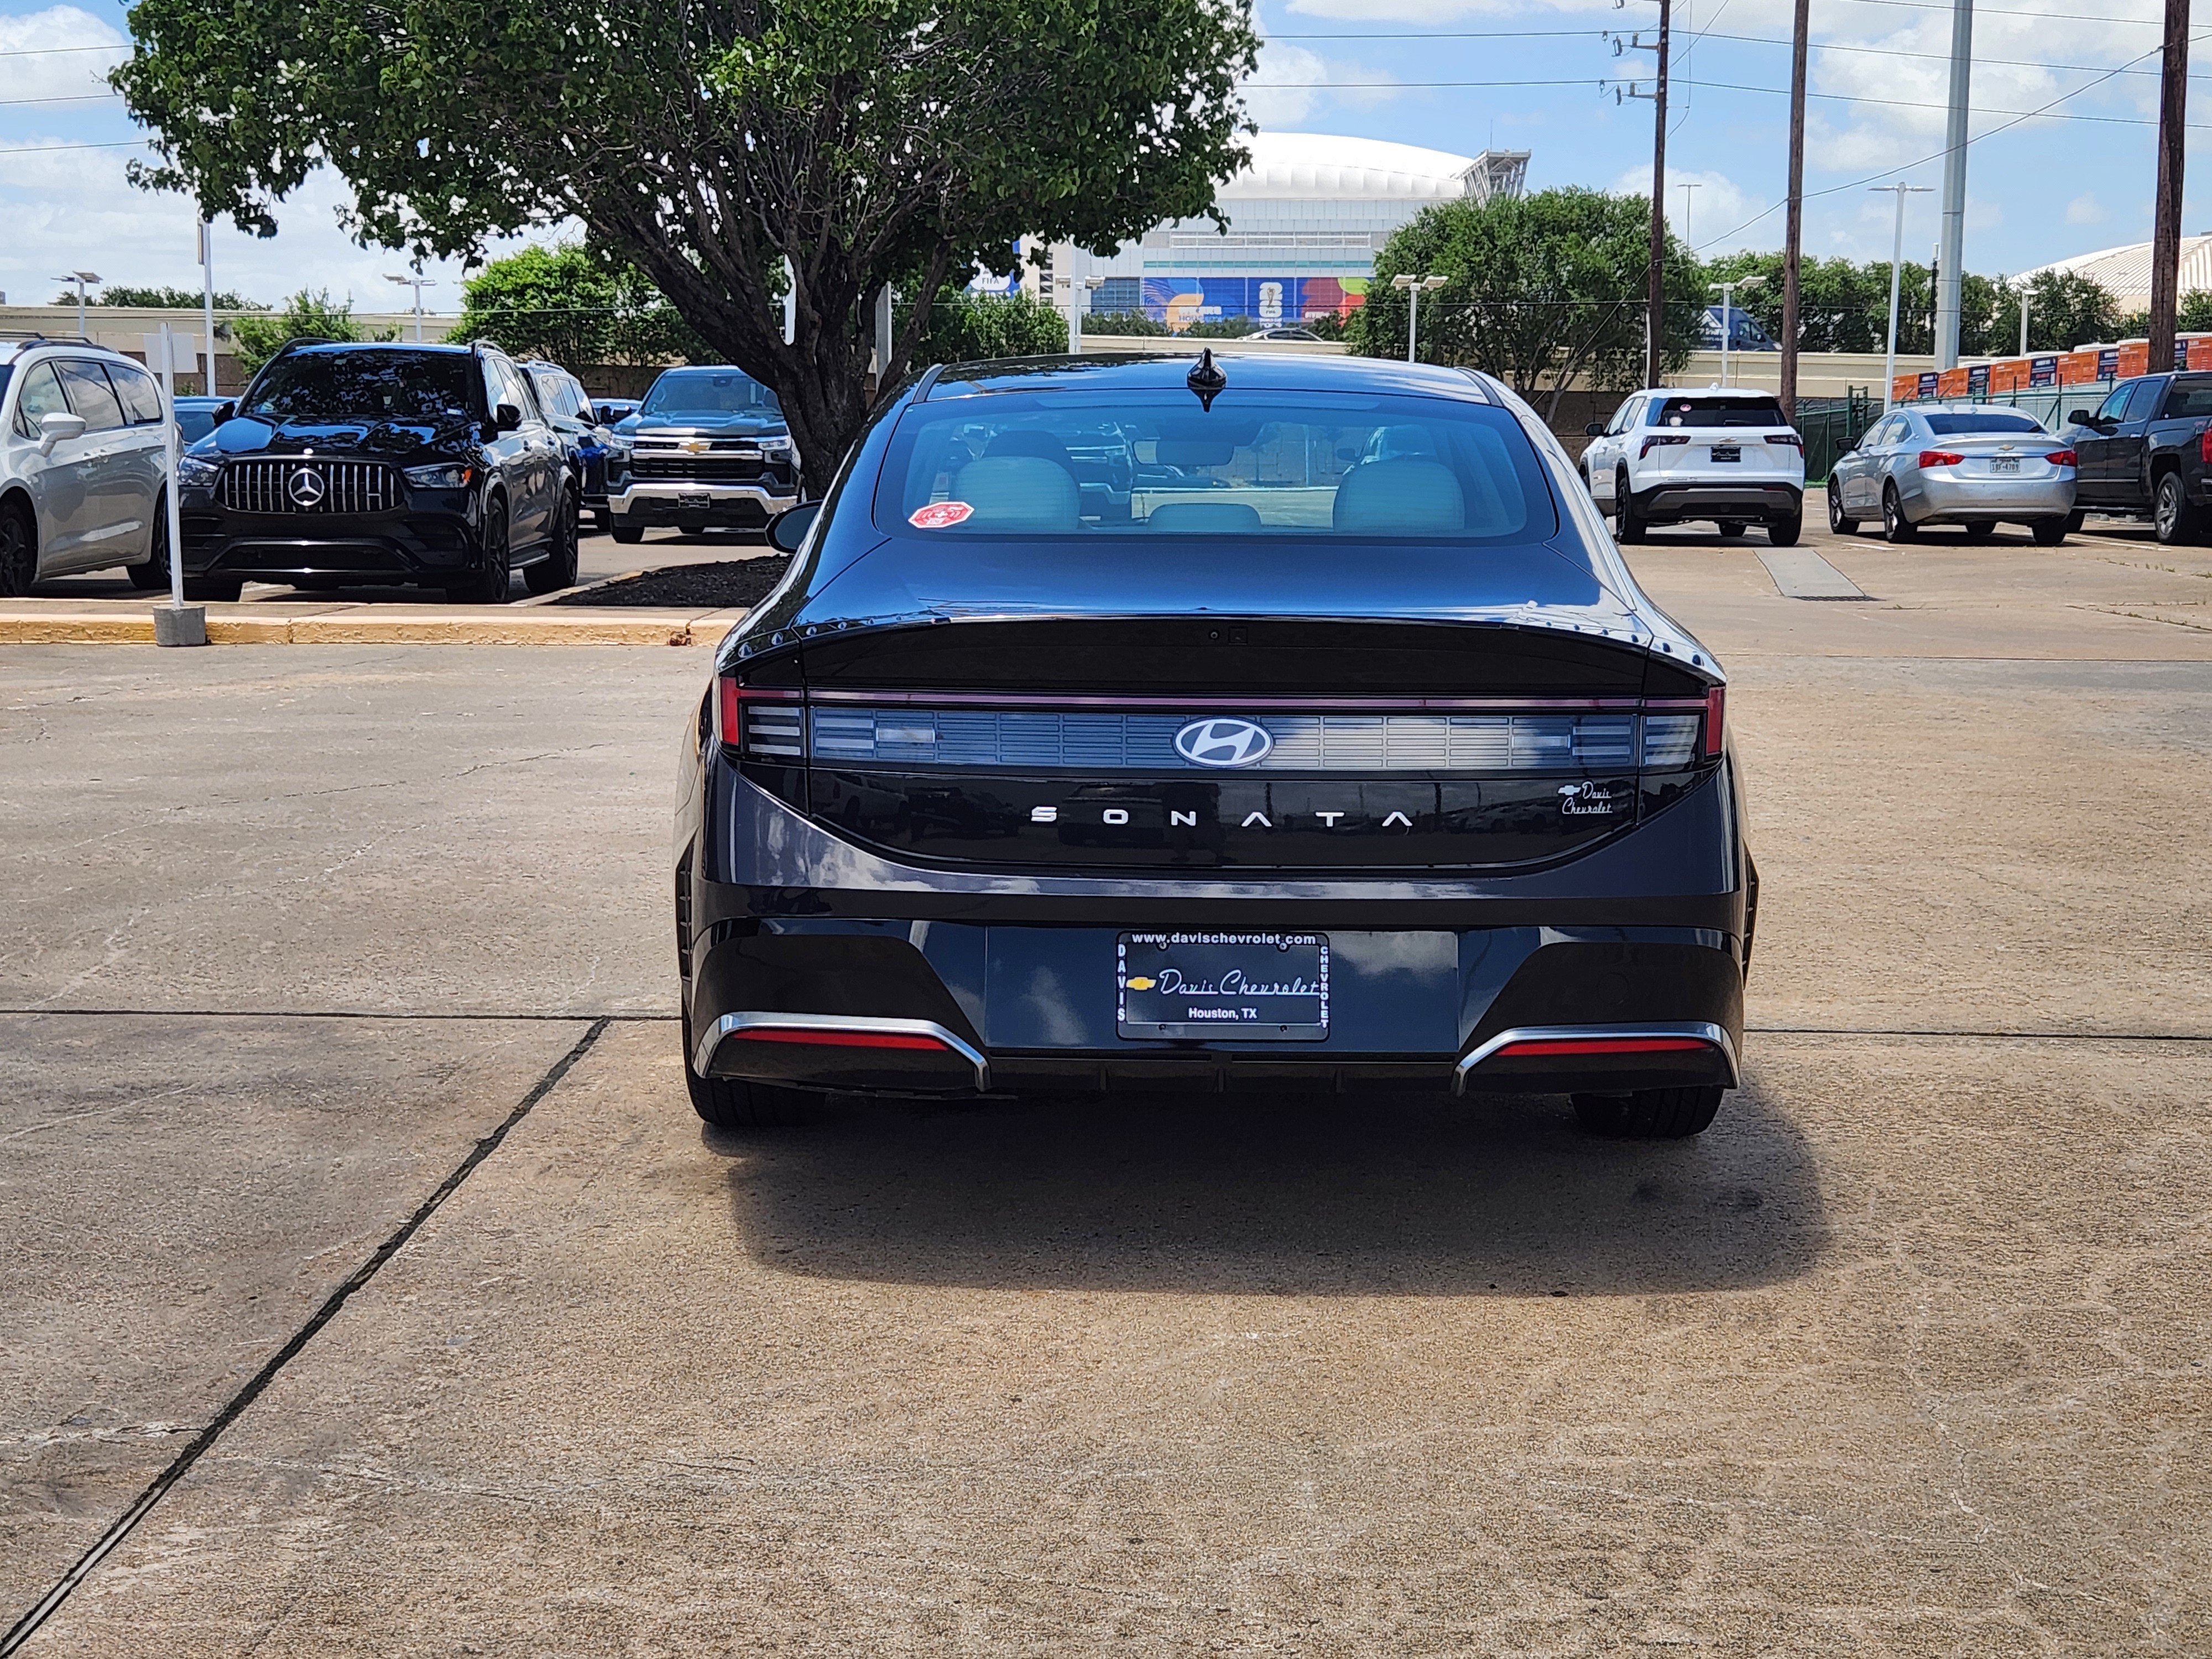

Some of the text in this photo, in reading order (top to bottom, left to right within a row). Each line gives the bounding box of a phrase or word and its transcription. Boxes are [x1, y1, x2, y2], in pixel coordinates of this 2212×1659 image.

[1582, 781, 1612, 799] Davis
[1562, 797, 1613, 815] Chevrolet
[1031, 806, 1412, 827] SONATA
[1131, 932, 1316, 945] www.davischevrolet.com
[1117, 943, 1126, 1022] DAVIS
[1159, 968, 1319, 996] Davis Chevrolet
[1319, 946, 1329, 1029] CHEVROLET
[1188, 1008, 1258, 1020] Houston, TX
